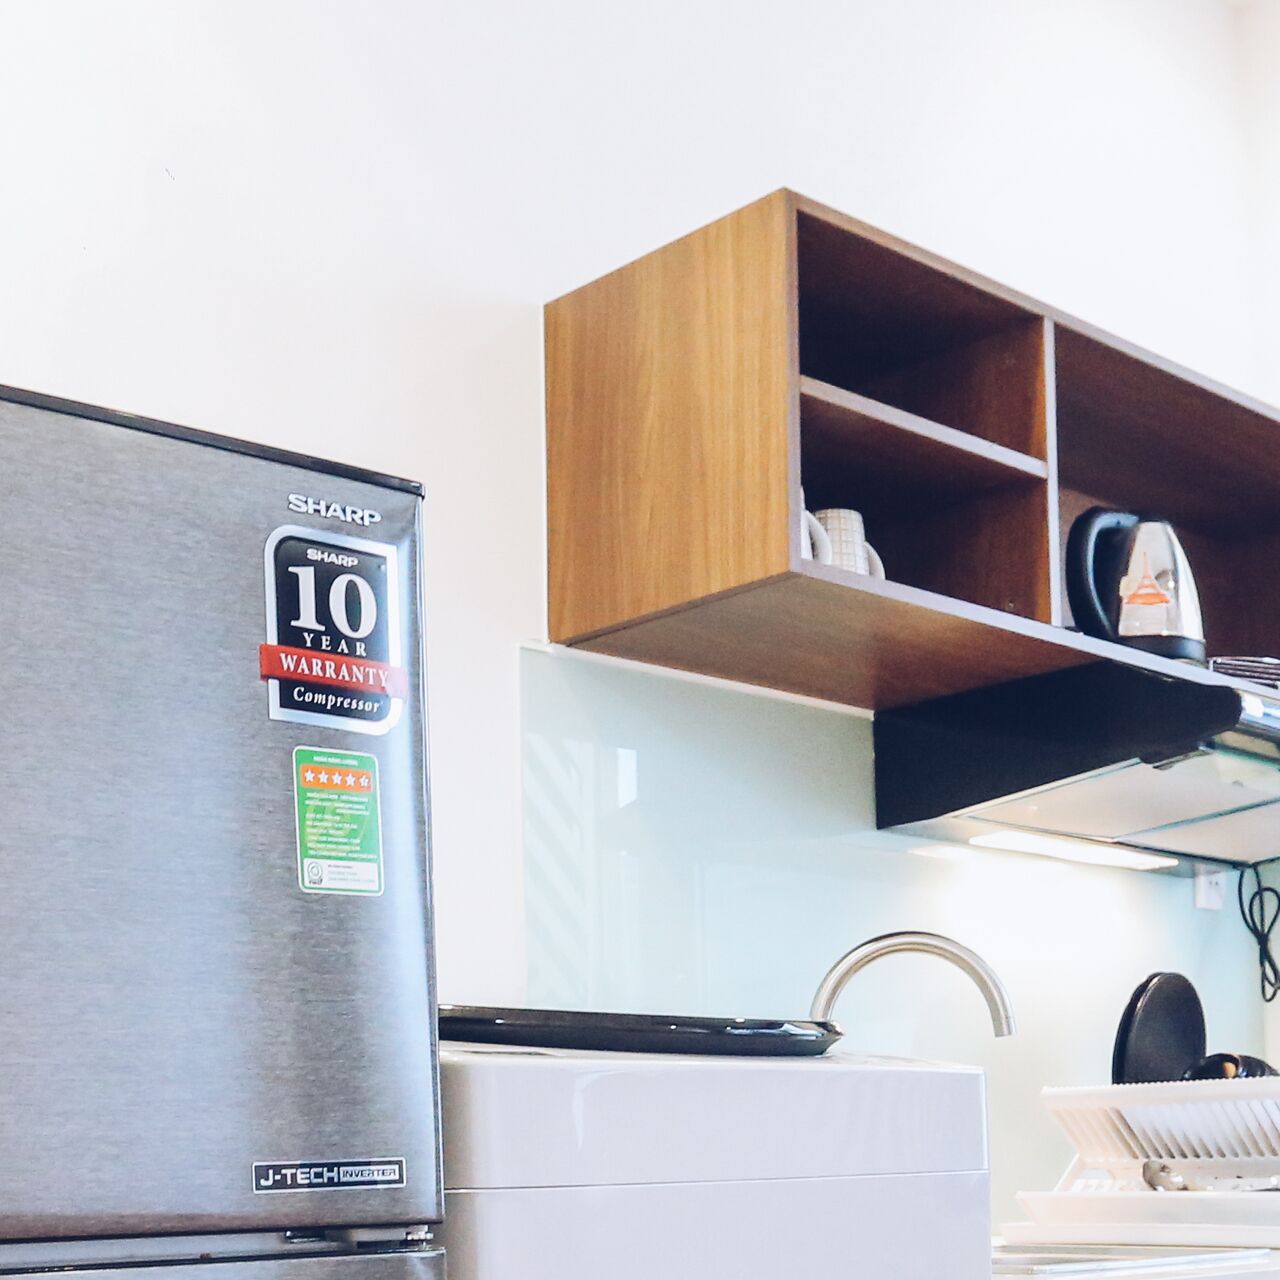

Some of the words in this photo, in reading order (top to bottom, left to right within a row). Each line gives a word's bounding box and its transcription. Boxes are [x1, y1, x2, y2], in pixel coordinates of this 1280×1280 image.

[287, 493, 382, 526] SHARP
[306, 548, 358, 567] SHARP
[288, 565, 377, 639] 10
[303, 632, 367, 656] YEAR
[280, 653, 389, 688] WARRANTY
[293, 687, 381, 712] Compressor
[260, 1167, 338, 1186] J-TECH
